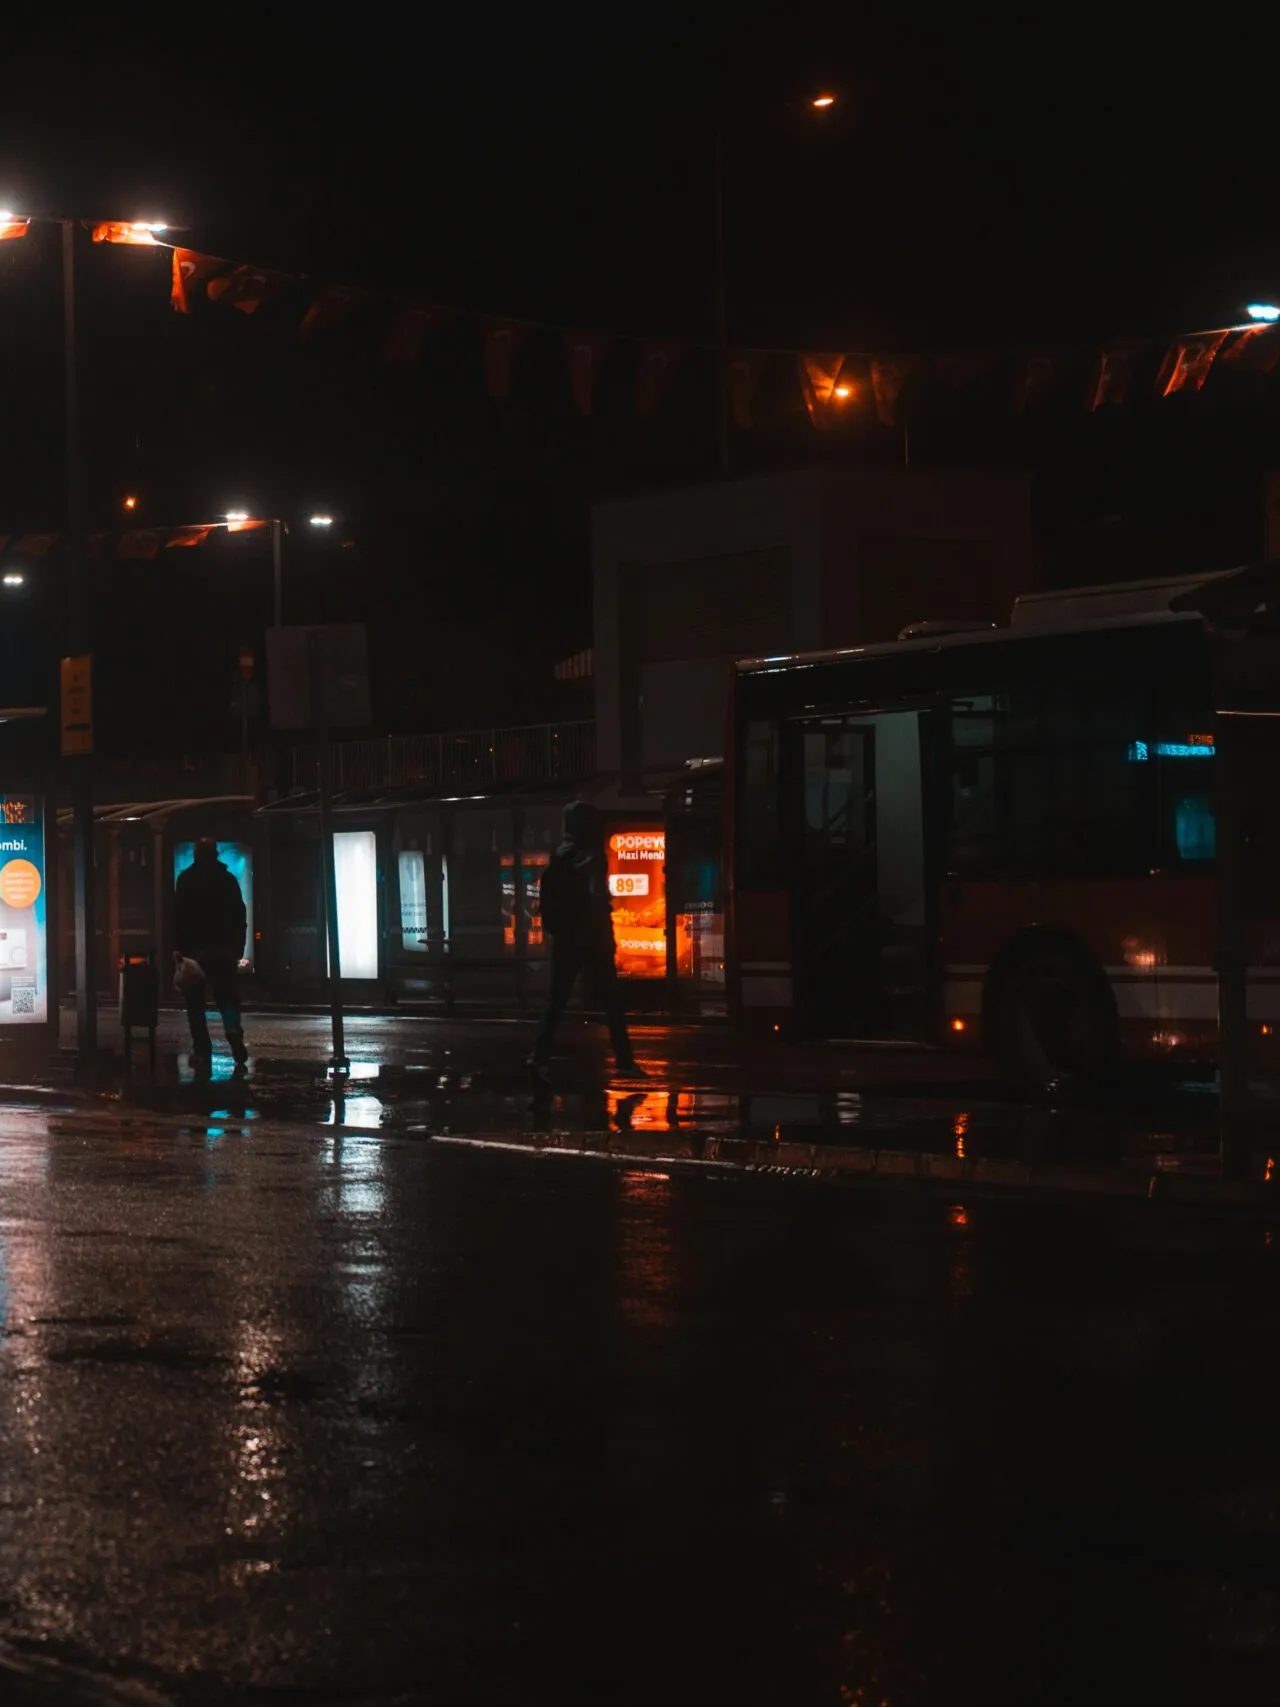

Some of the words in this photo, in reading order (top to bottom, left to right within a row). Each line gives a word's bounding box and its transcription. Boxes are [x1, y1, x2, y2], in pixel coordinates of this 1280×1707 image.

[617, 850, 639, 860] Maxi
[616, 878, 634, 893] 89
[621, 940, 666, 950] POPEYE
